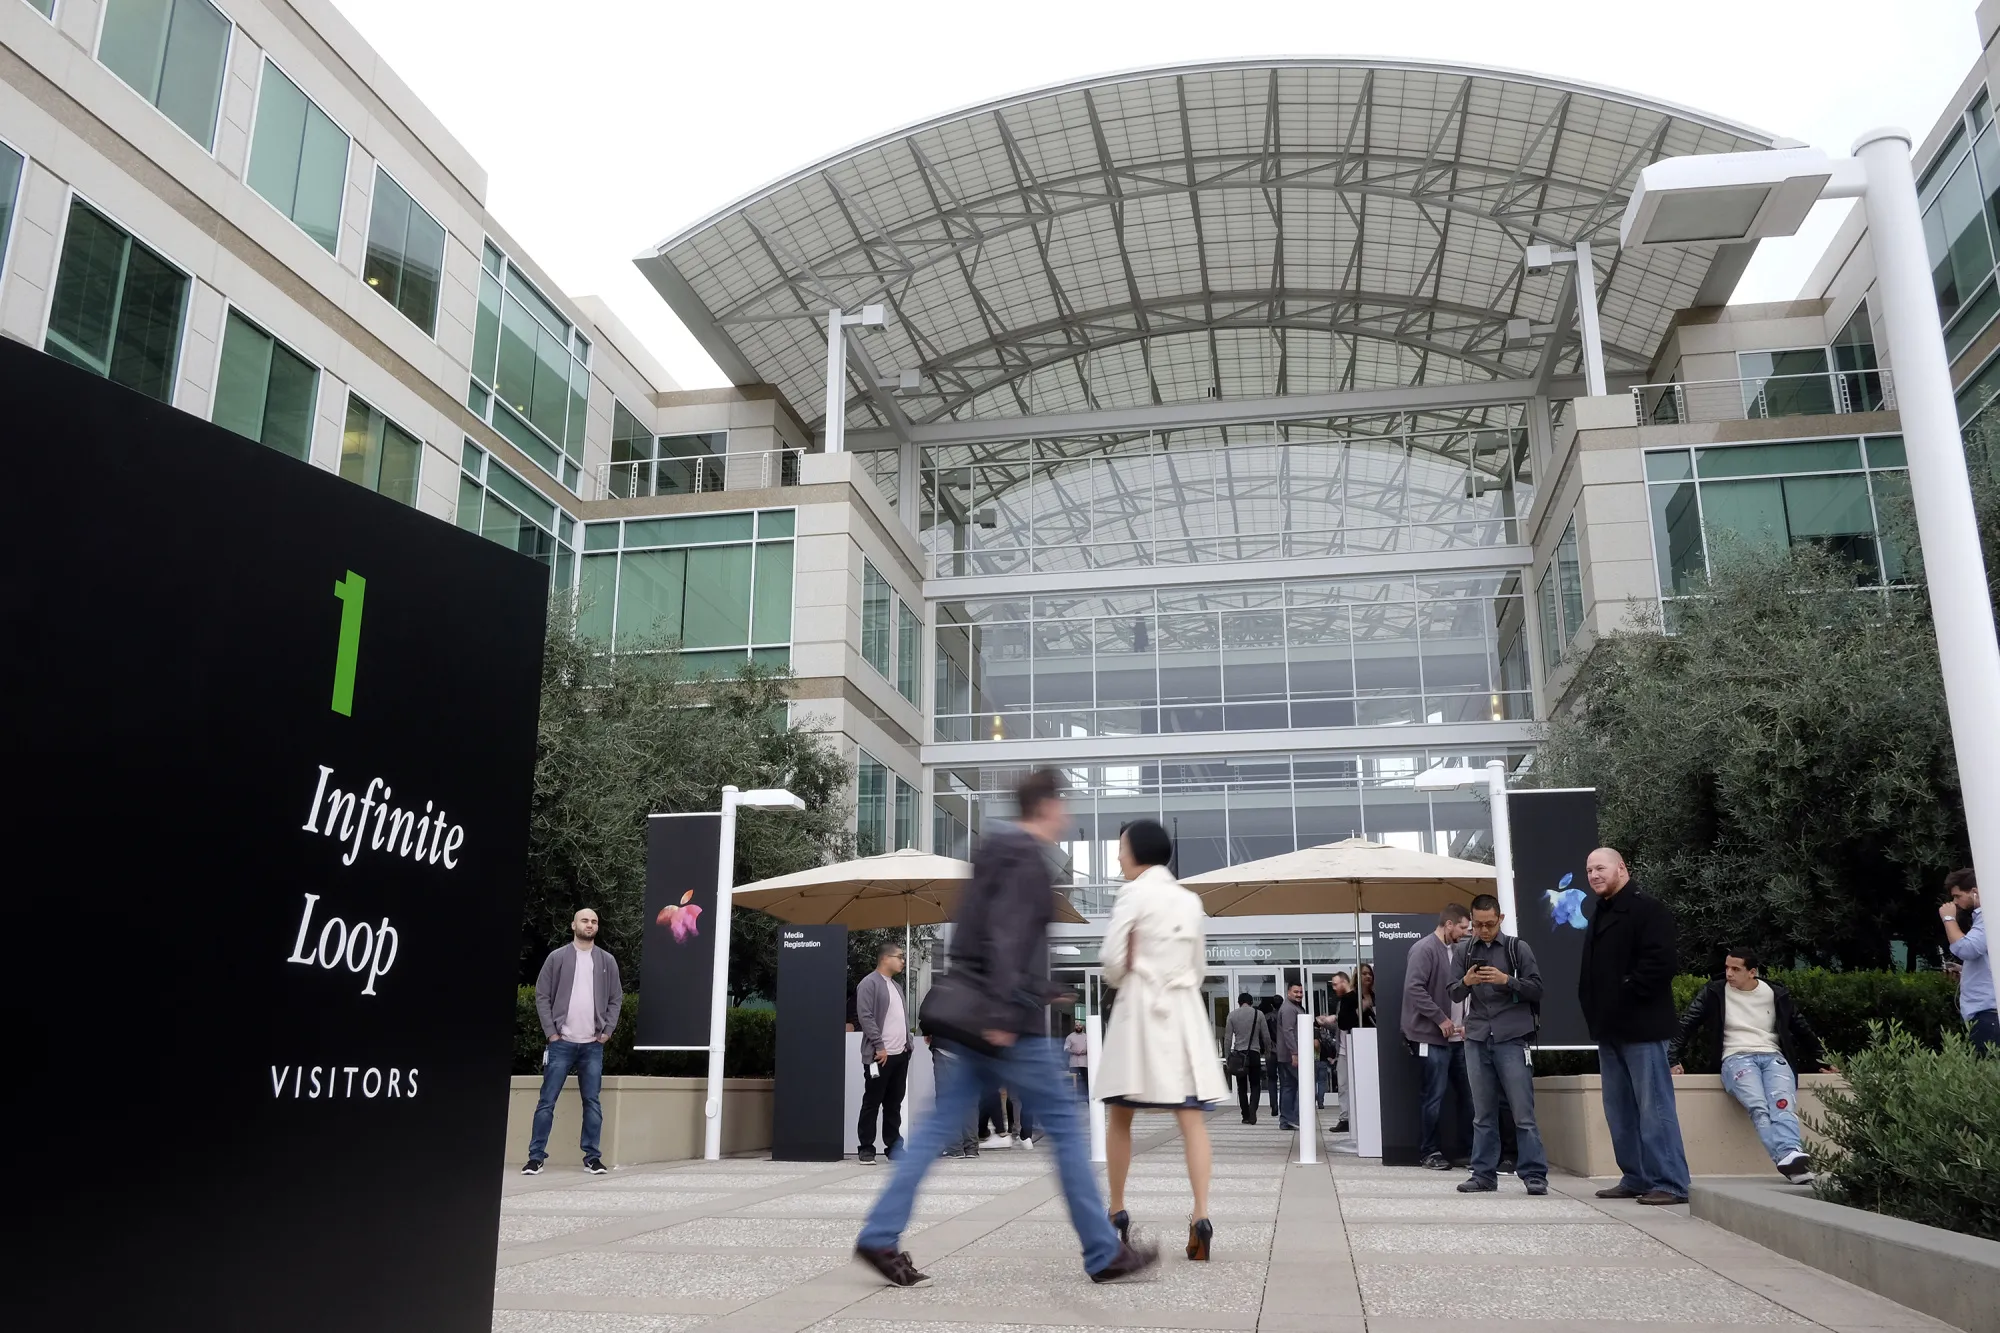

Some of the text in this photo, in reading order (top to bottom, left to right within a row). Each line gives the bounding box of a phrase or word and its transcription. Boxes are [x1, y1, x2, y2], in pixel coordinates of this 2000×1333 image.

[331, 569, 367, 718] 1
[302, 764, 465, 870] Infinite
[1378, 921, 1401, 929] Guest
[784, 931, 804, 939] Media
[1379, 931, 1422, 940] Registration
[287, 892, 399, 996] Loop
[784, 940, 821, 949] Registration
[1204, 946, 1272, 959] nfinite Loop
[271, 1065, 419, 1099] VISITORS
